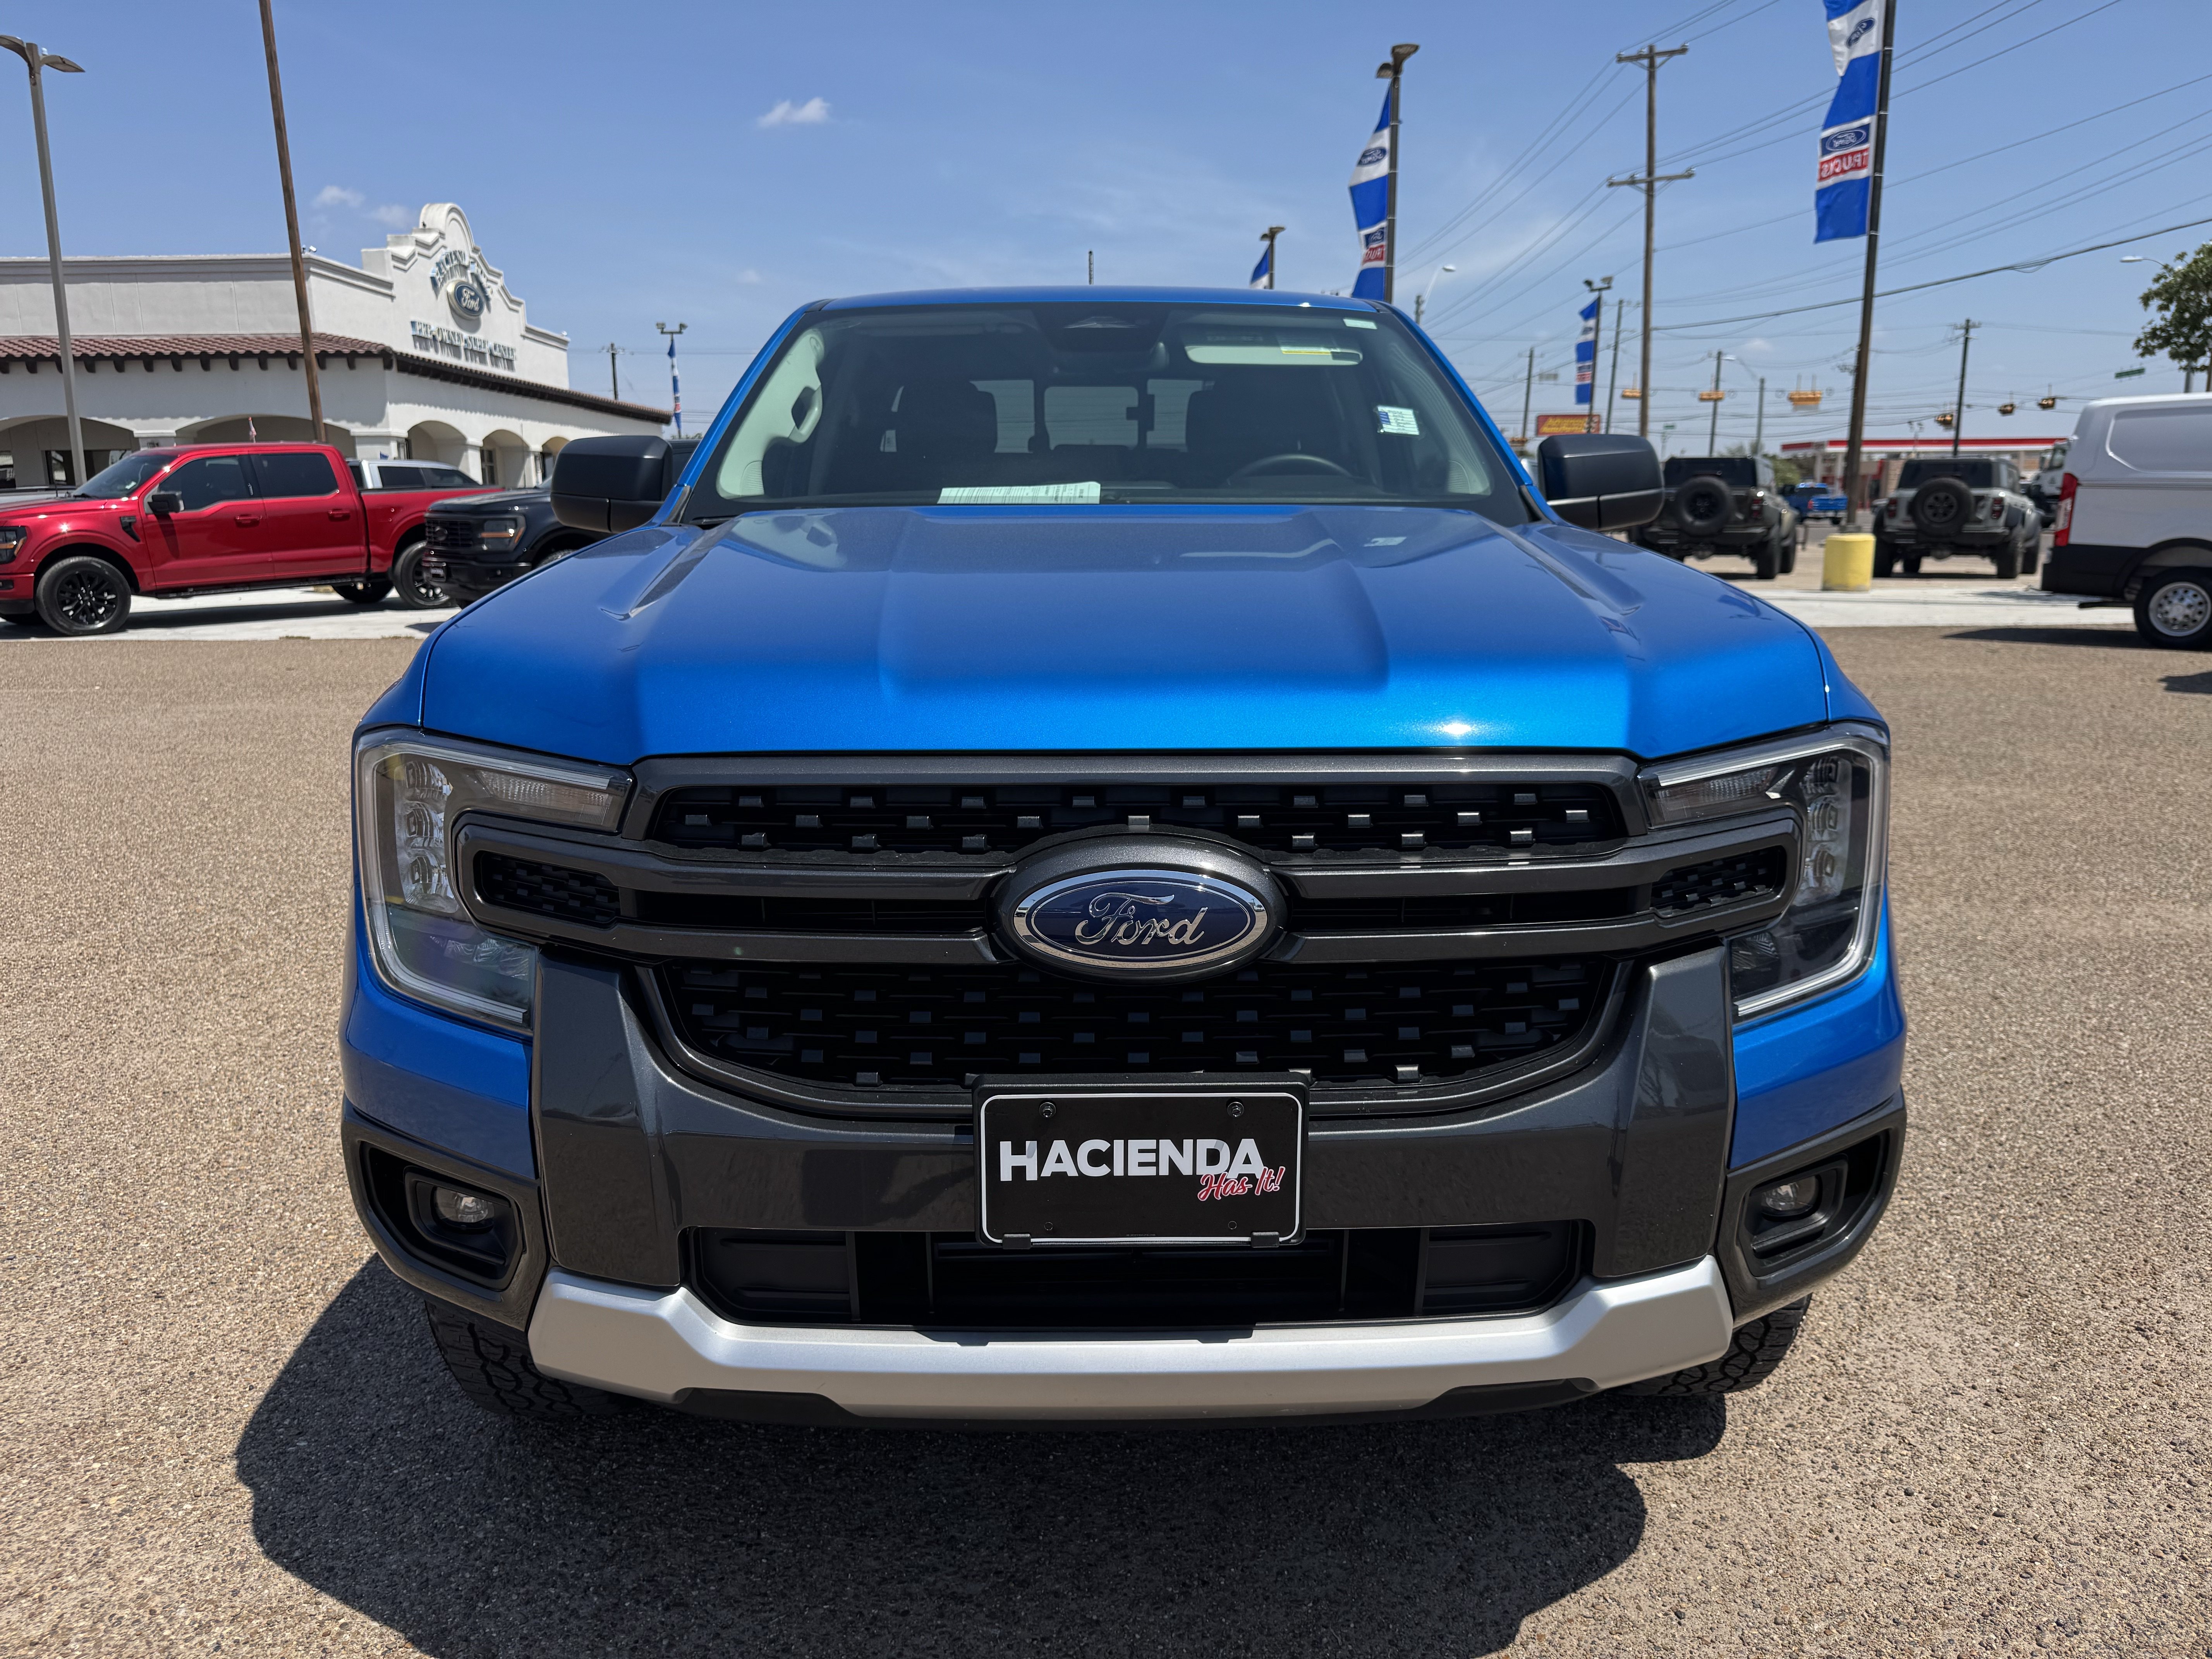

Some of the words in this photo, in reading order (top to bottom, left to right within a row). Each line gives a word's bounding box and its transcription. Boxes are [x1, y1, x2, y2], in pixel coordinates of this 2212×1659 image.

[460, 287, 480, 312] Ford
[1074, 892, 1209, 945] Ford
[999, 1138, 1265, 1182] HACIENDA
[1197, 1171, 1252, 1202] Has
[1255, 1166, 1286, 1196] It!
